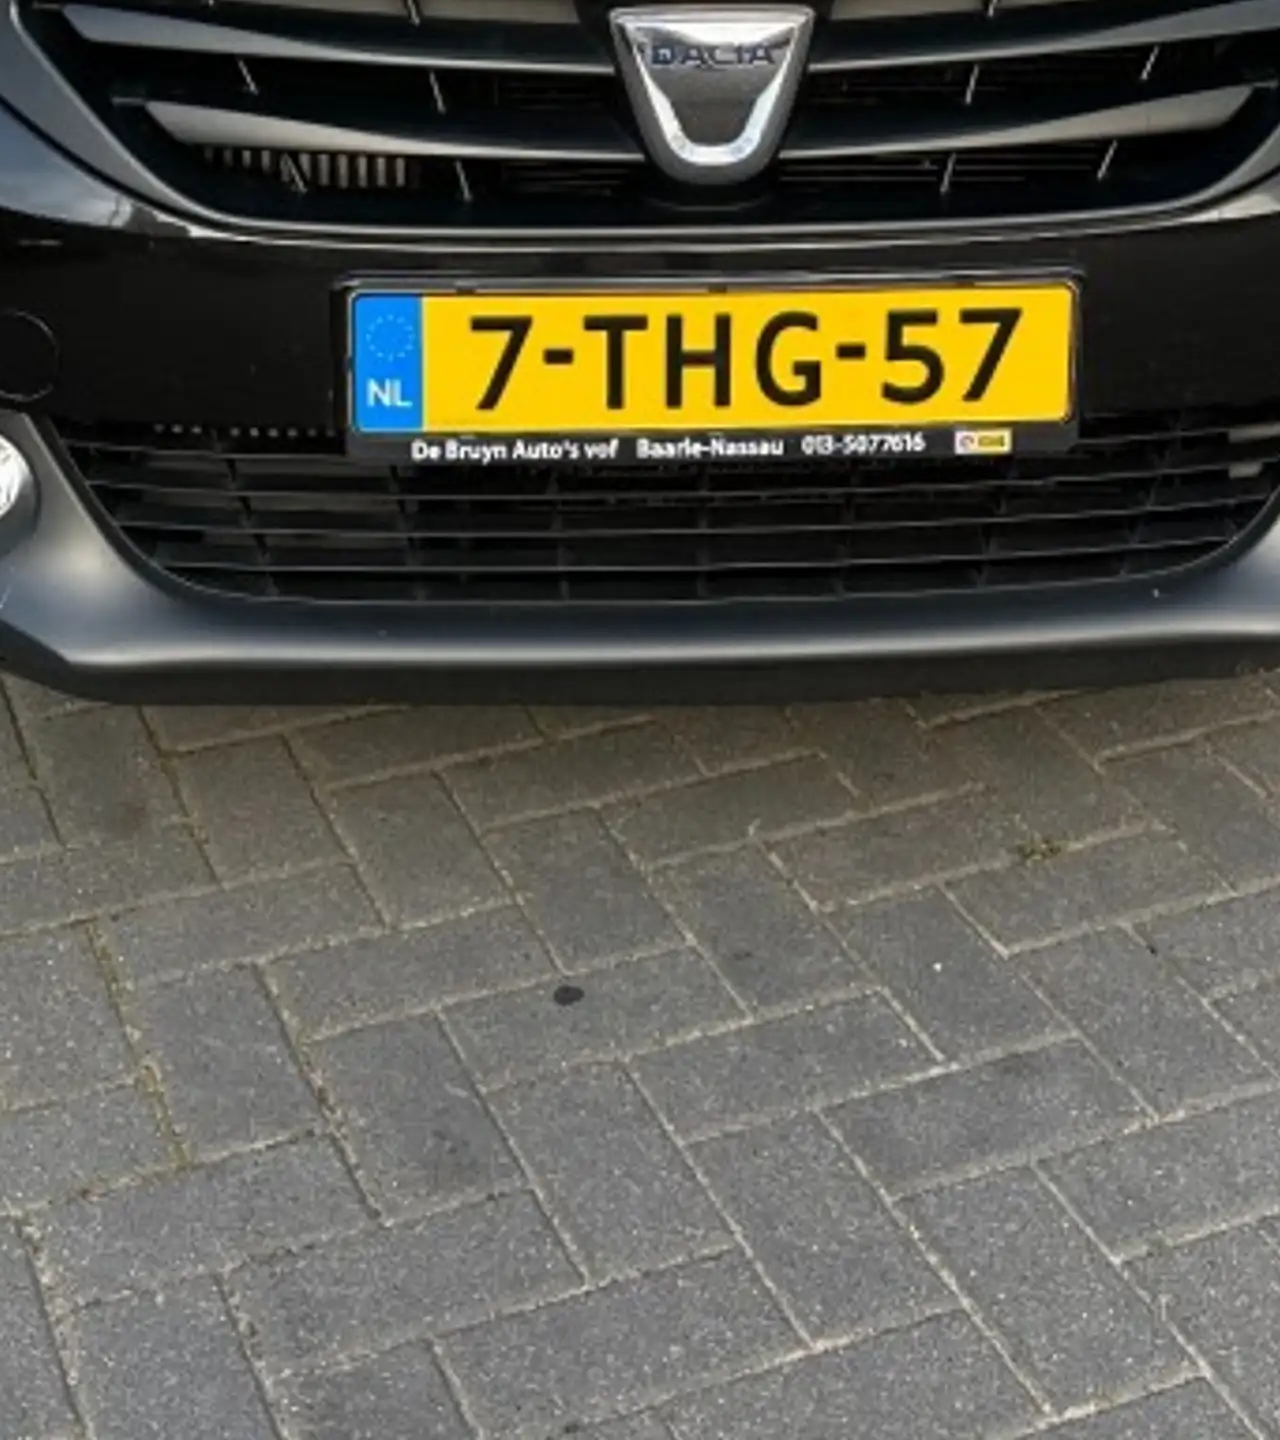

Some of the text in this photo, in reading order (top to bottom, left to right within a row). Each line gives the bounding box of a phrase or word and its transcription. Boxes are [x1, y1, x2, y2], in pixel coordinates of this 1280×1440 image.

[650, 44, 776, 66] DACIA
[469, 307, 1024, 410] 7-THG-57
[366, 378, 414, 407] NL
[411, 438, 441, 459] De
[445, 438, 507, 465] Bruyn
[512, 438, 580, 459] Auto's
[584, 438, 619, 458] vof
[636, 436, 784, 458] Baarle-Nassau
